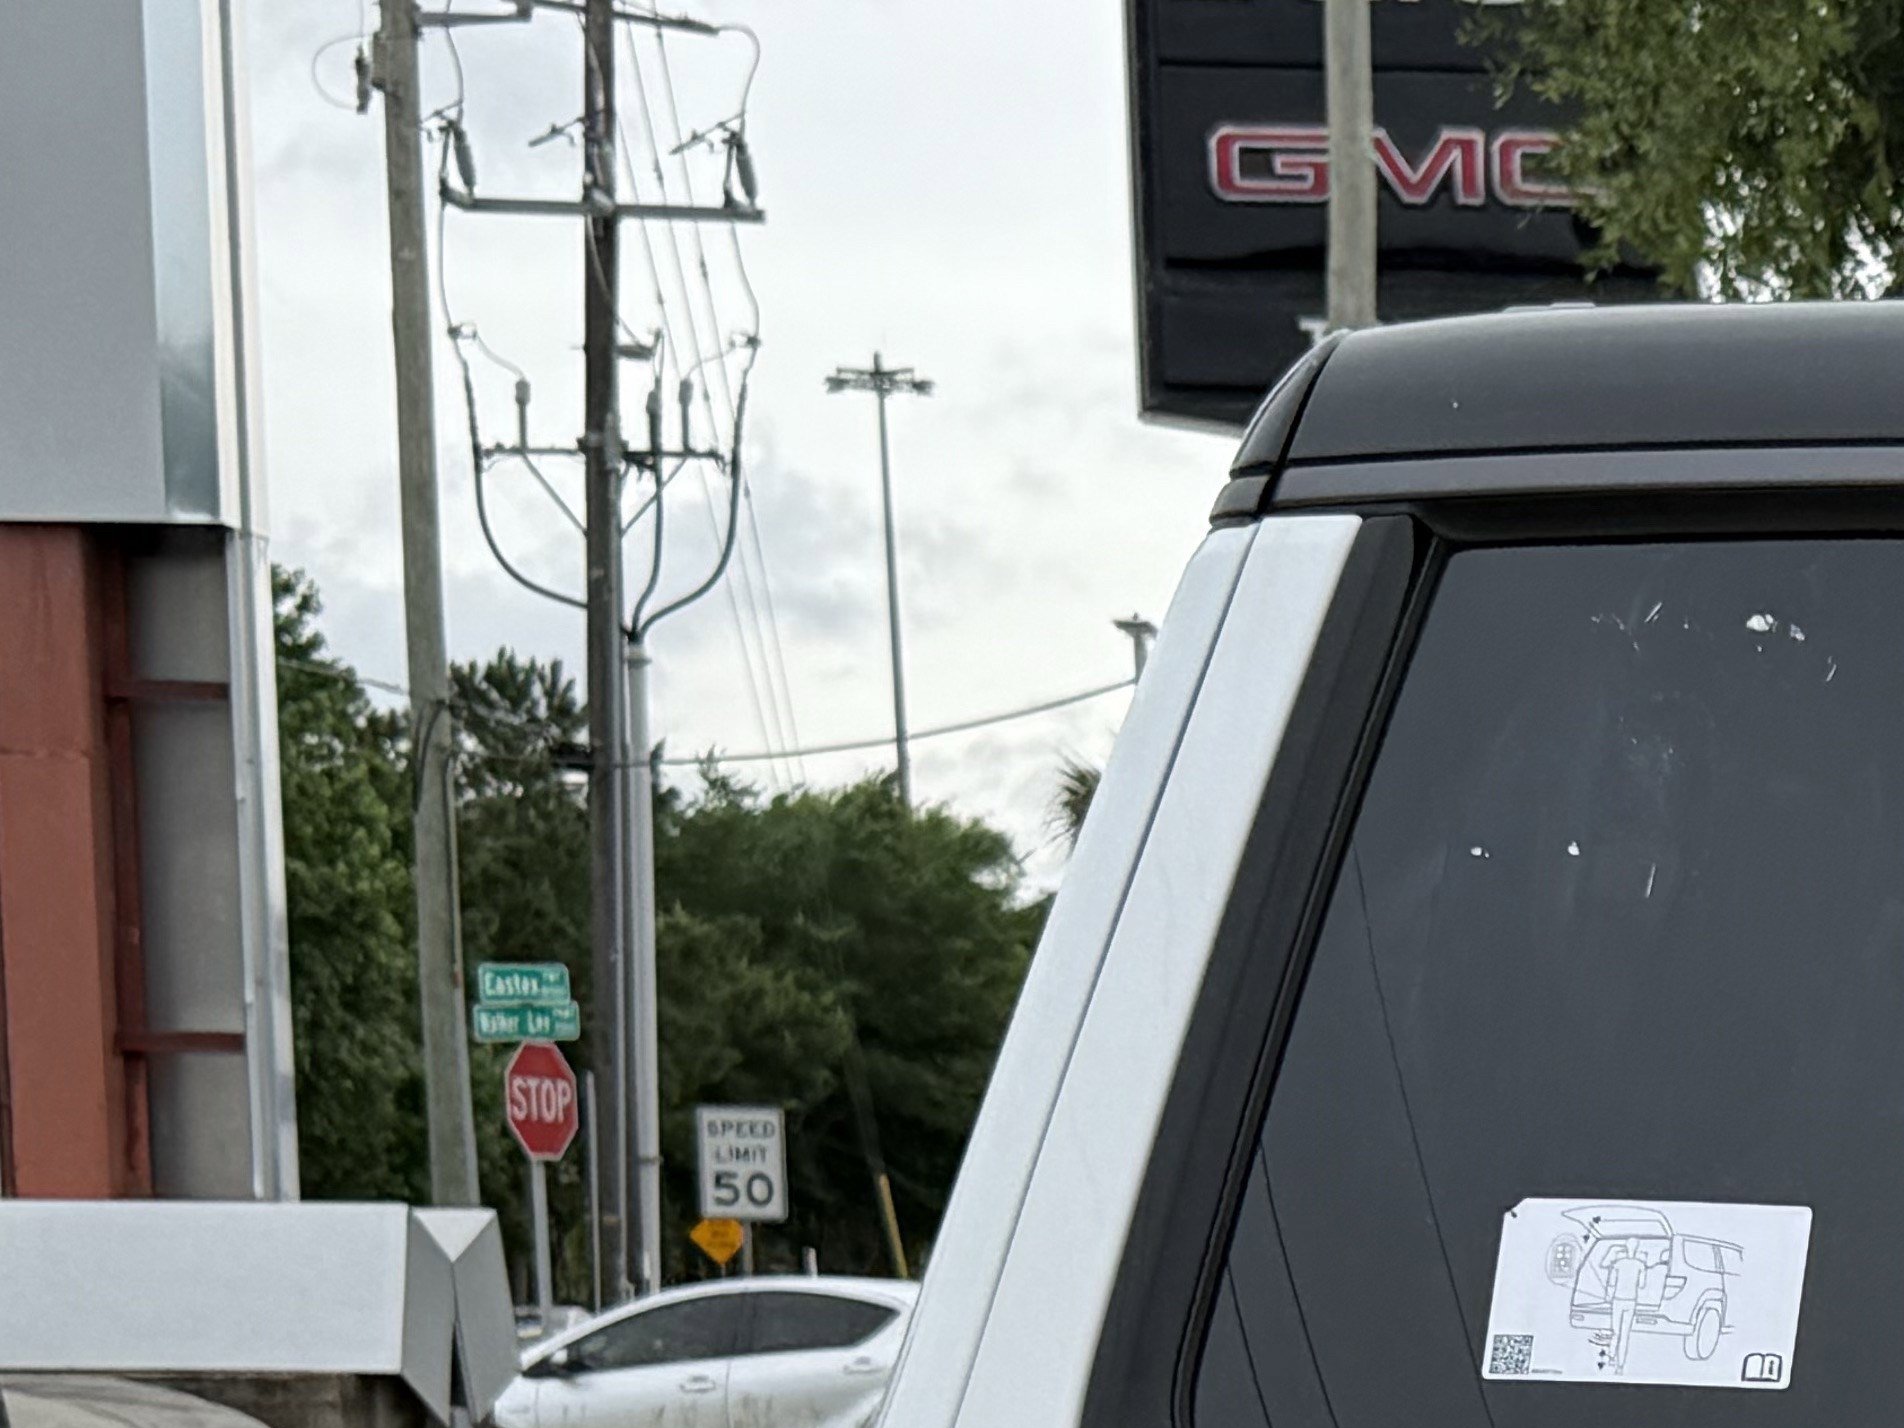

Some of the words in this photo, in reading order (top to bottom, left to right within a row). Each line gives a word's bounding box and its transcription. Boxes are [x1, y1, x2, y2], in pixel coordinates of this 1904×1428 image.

[1209, 125, 1602, 207] GMC
[511, 1076, 572, 1123] STOP
[707, 1119, 776, 1138] SPEED
[715, 1145, 767, 1164] LIMIT
[714, 1171, 773, 1208] 50
